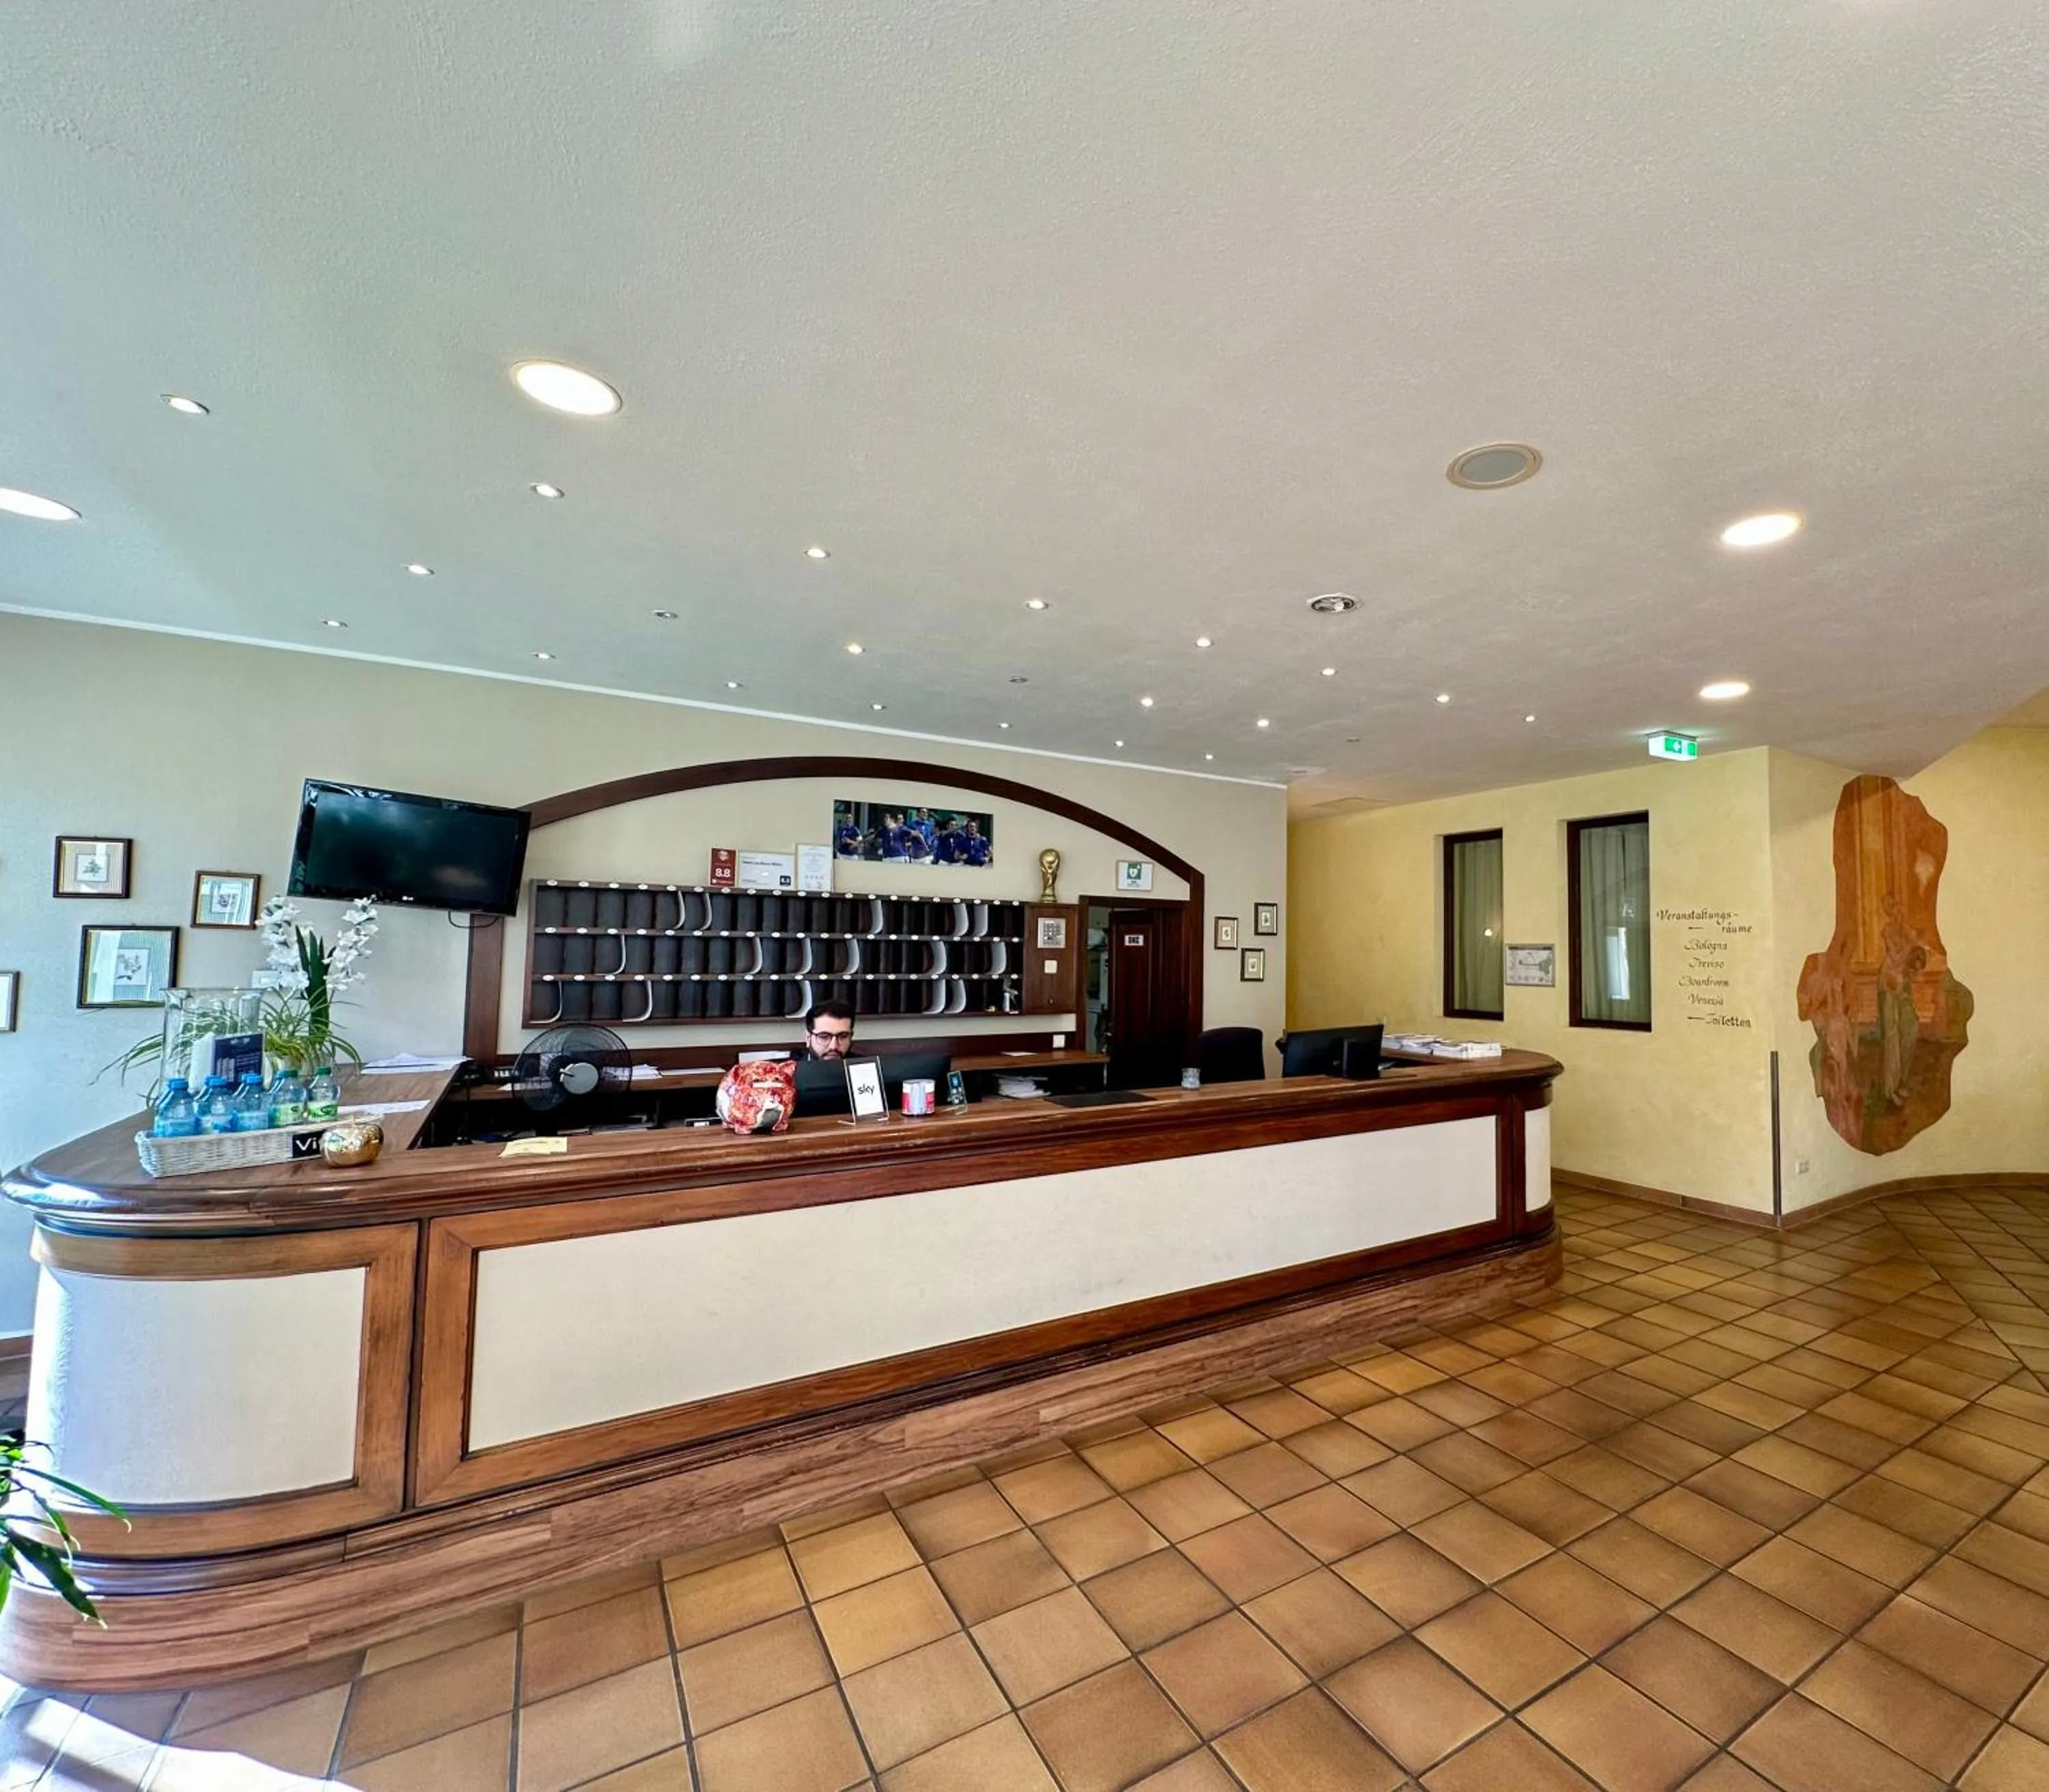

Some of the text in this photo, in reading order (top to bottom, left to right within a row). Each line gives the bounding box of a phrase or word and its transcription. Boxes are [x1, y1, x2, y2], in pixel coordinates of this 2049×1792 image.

[1684, 939, 1728, 955] Bologna
[1705, 1013, 1752, 1028] Toiletten
[857, 1084, 875, 1095] sky
[296, 1137, 318, 1151] Vi
